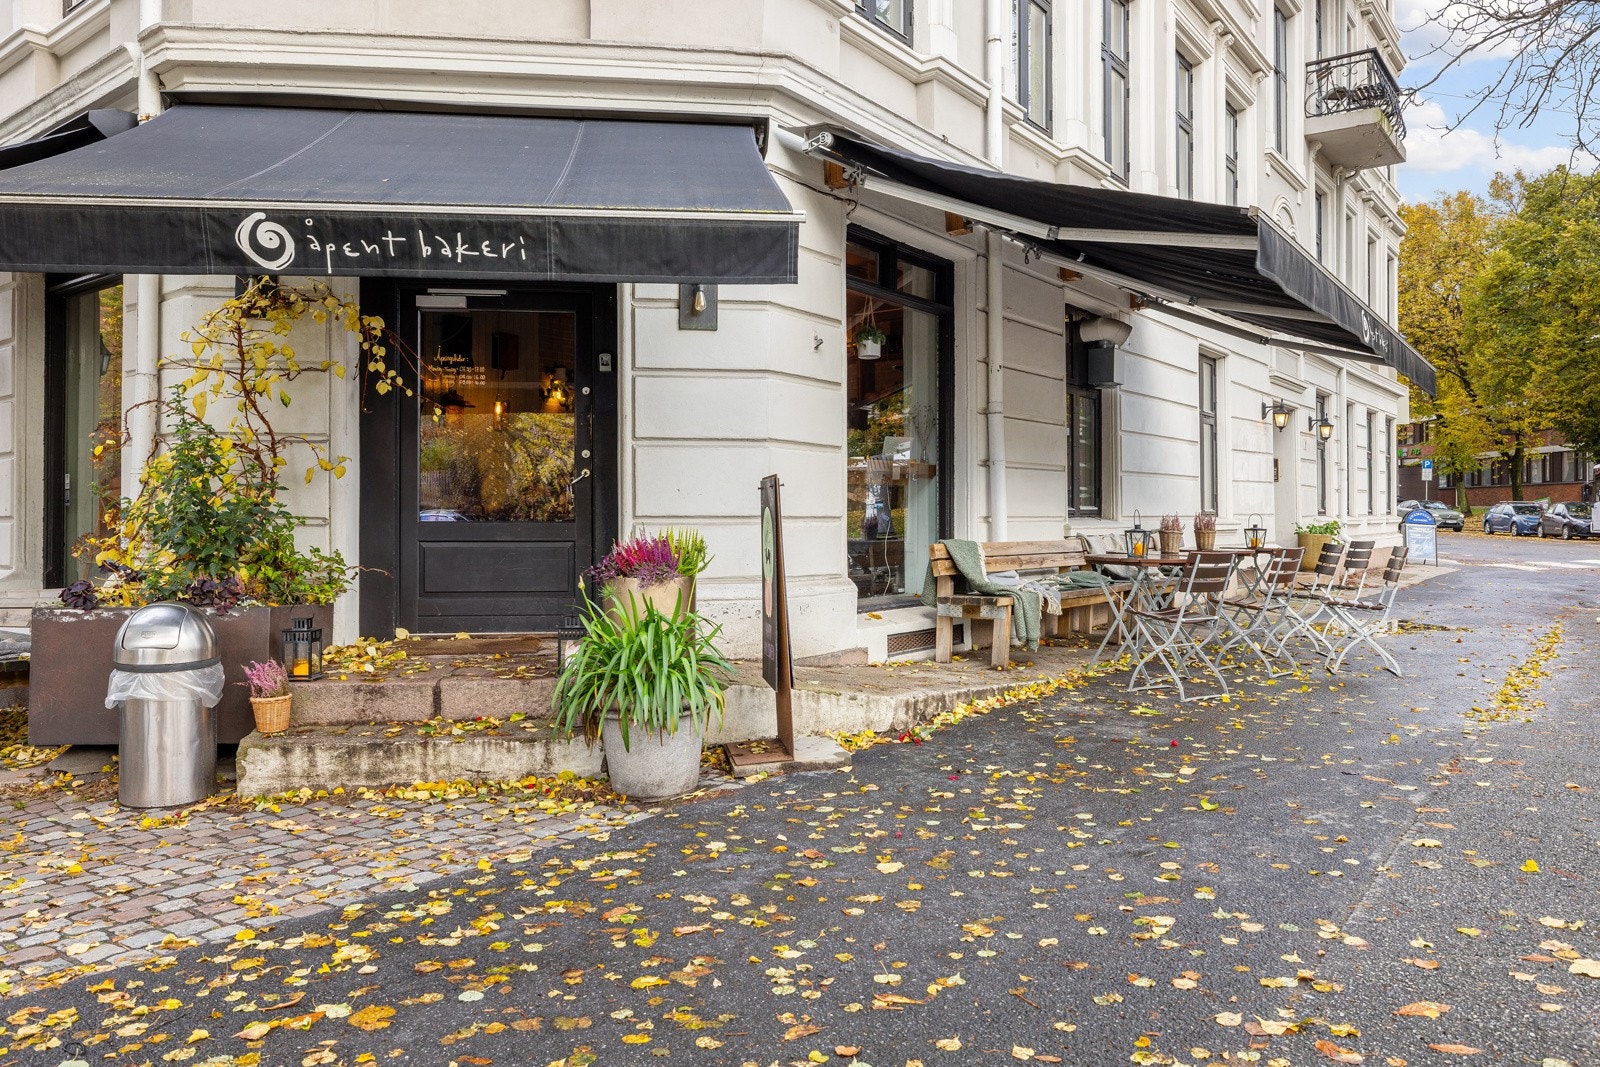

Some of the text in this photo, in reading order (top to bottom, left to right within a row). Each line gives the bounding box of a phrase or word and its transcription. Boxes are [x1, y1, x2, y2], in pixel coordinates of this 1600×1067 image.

[305, 218, 527, 273] åpent bakeri
[1424, 460, 1431, 468] P
